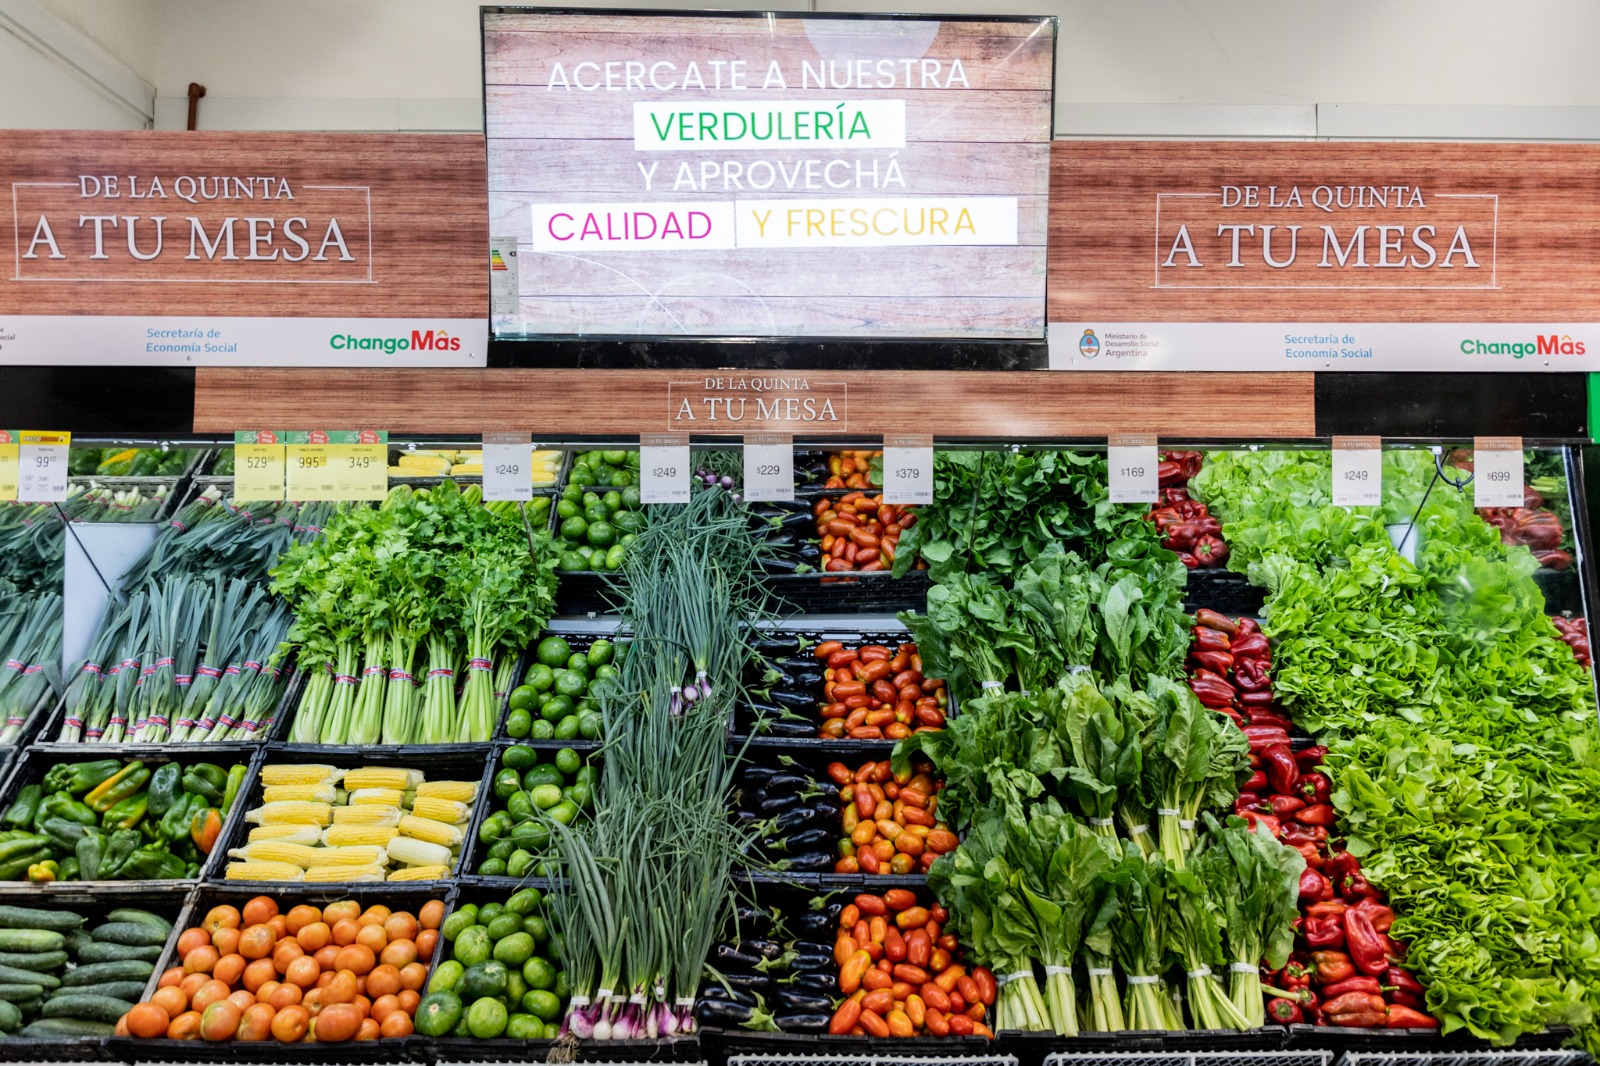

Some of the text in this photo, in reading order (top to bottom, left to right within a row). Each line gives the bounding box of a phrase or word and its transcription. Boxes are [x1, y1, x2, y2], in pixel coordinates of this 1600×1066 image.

[547, 57, 970, 93] ACERCATE A NUESTRA
[650, 103, 872, 142] VERDULERÍA
[637, 151, 906, 191] Y APROVECHÁ
[78, 175, 295, 204] DE LA QUINTA
[1220, 185, 1427, 213] DE LA QUINTA
[547, 206, 977, 242] CALIDAD Y FRESCURA
[21, 214, 356, 262] A TU MESA
[1161, 224, 1481, 269] A TU MESA
[146, 327, 221, 339] Secretaría de
[1104, 332, 1147, 340] Ministerio de
[1105, 340, 1160, 348] Desarrollo Social
[1284, 334, 1355, 344] Secretaría de
[145, 342, 238, 353] Economía Social
[1105, 349, 1148, 359] Argentina
[1285, 348, 1373, 359] Economía Social
[704, 377, 810, 392] DE LA QUINTA
[674, 397, 839, 421] A TU MESA
[495, 464, 519, 475] $249
[652, 466, 677, 478] $249
[756, 465, 780, 476] $229
[895, 468, 920, 479] $379
[1120, 466, 1145, 477] $169
[1344, 470, 1368, 481] $249
[1487, 471, 1510, 482] $699
